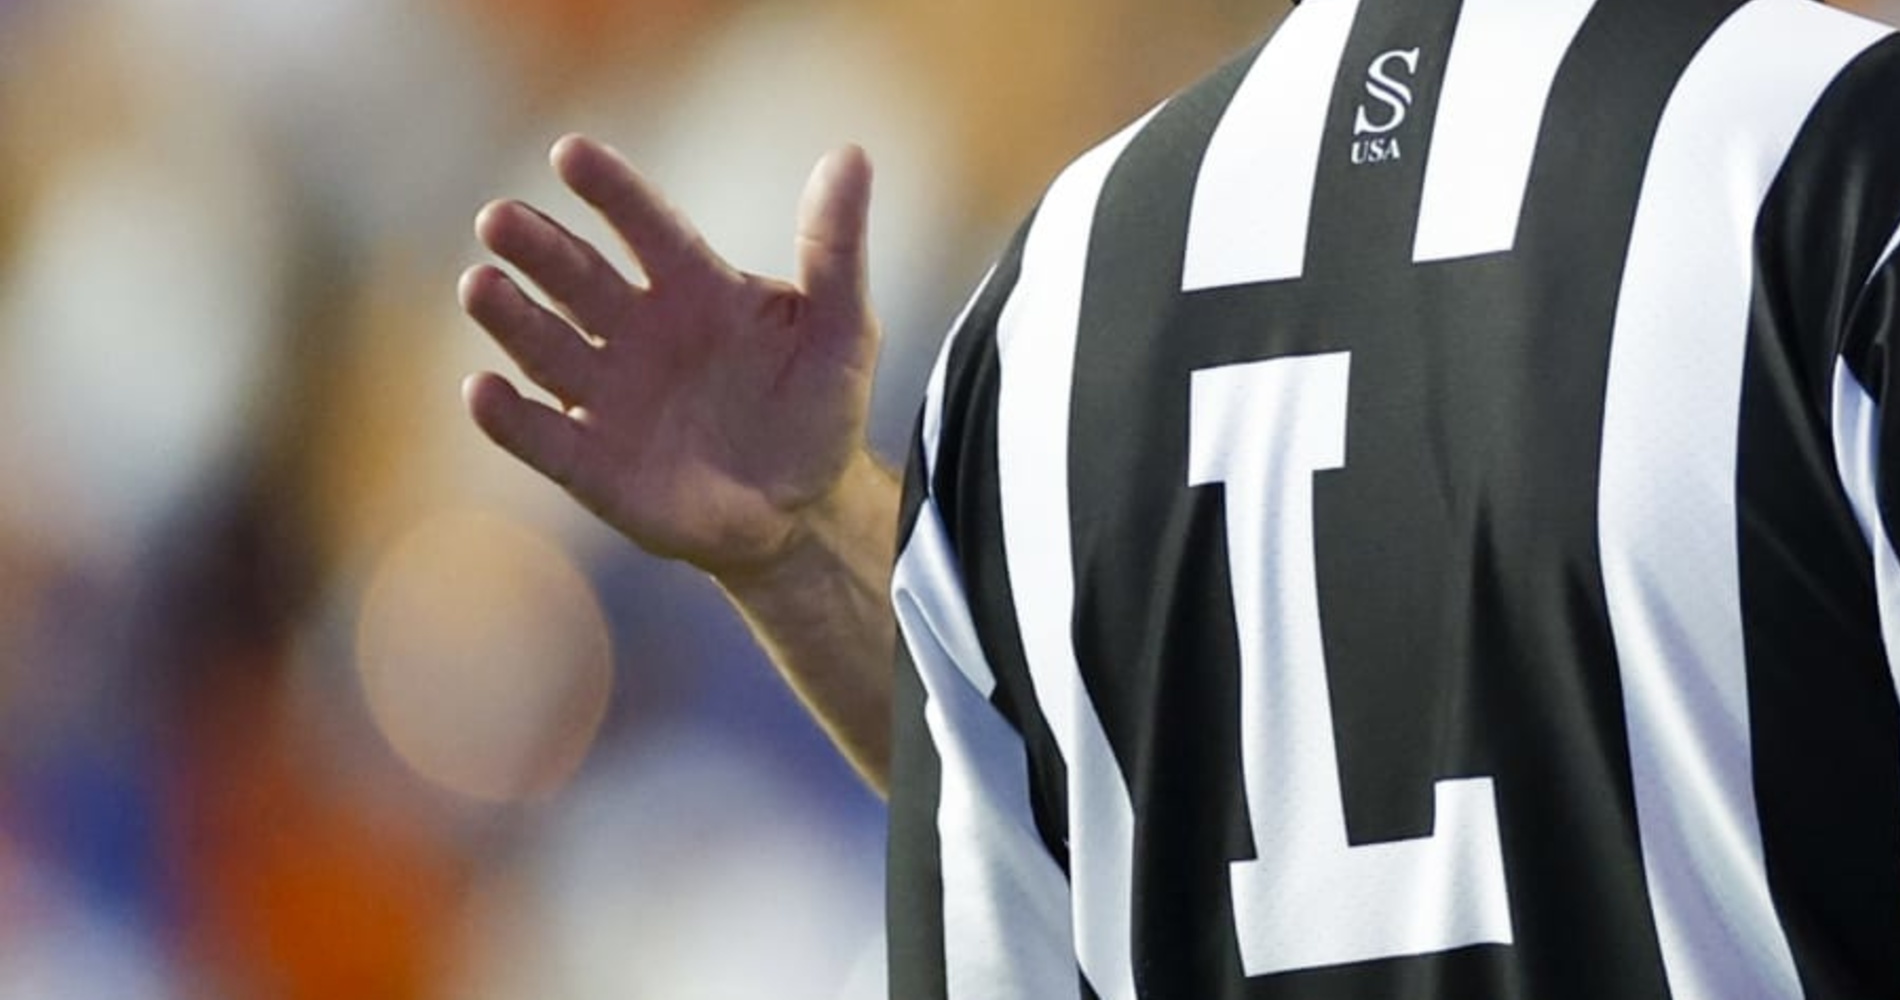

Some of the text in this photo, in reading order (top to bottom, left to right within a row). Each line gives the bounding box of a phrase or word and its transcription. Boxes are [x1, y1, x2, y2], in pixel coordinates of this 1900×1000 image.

[1353, 47, 1420, 135] S
[1350, 138, 1400, 164] USA
[1188, 351, 1513, 977] L
